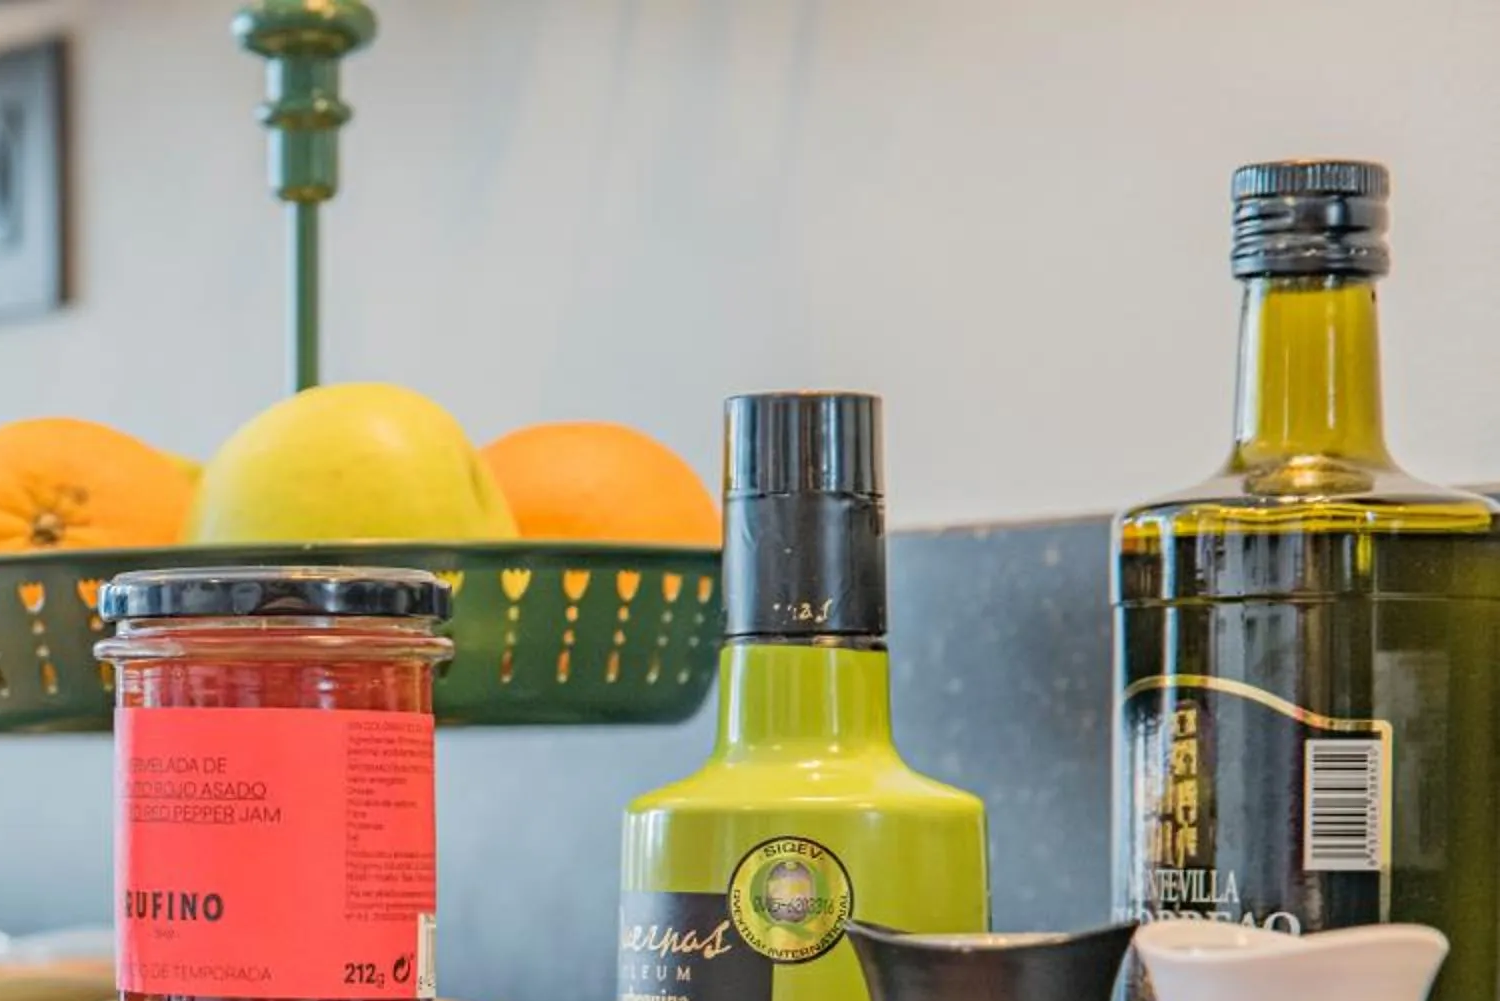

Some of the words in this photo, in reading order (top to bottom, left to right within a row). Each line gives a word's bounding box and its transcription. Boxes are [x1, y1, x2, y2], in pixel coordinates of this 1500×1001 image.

[203, 757, 228, 774] DE
[201, 781, 267, 800] ASADO
[173, 804, 236, 823] PEPPER
[238, 807, 282, 823] JAM
[344, 961, 384, 990] 212g
